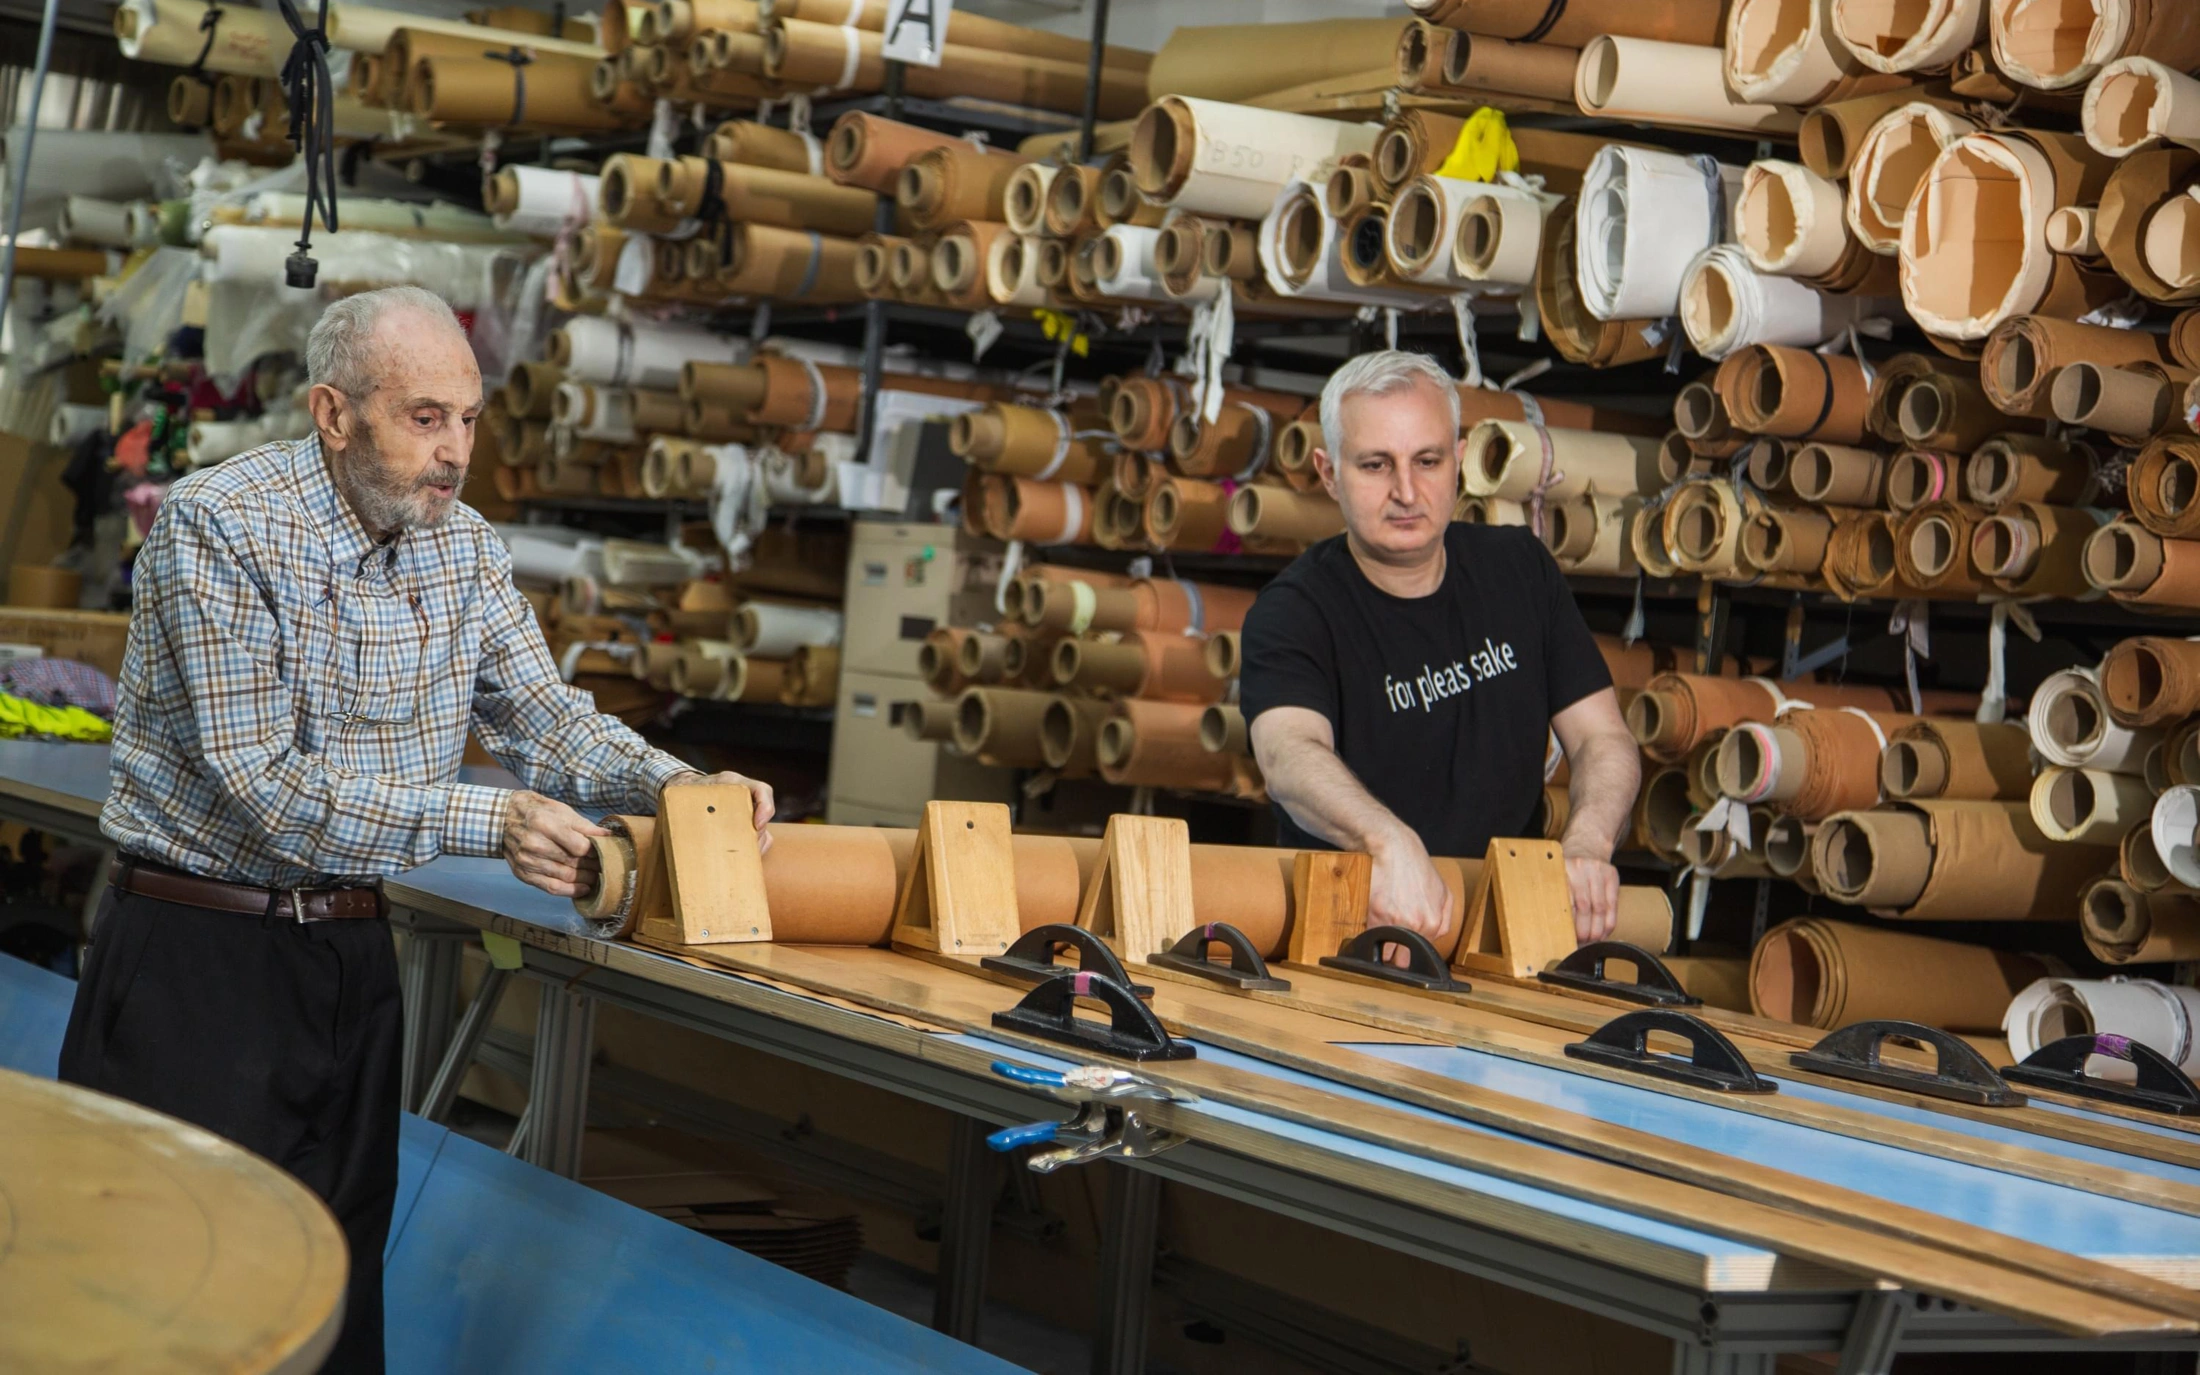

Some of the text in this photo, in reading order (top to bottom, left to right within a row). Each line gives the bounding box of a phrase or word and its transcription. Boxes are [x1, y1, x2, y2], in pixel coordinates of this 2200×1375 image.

[889, 0, 935, 52] A
[1384, 673, 1416, 713] for
[1469, 636, 1518, 682] sake
